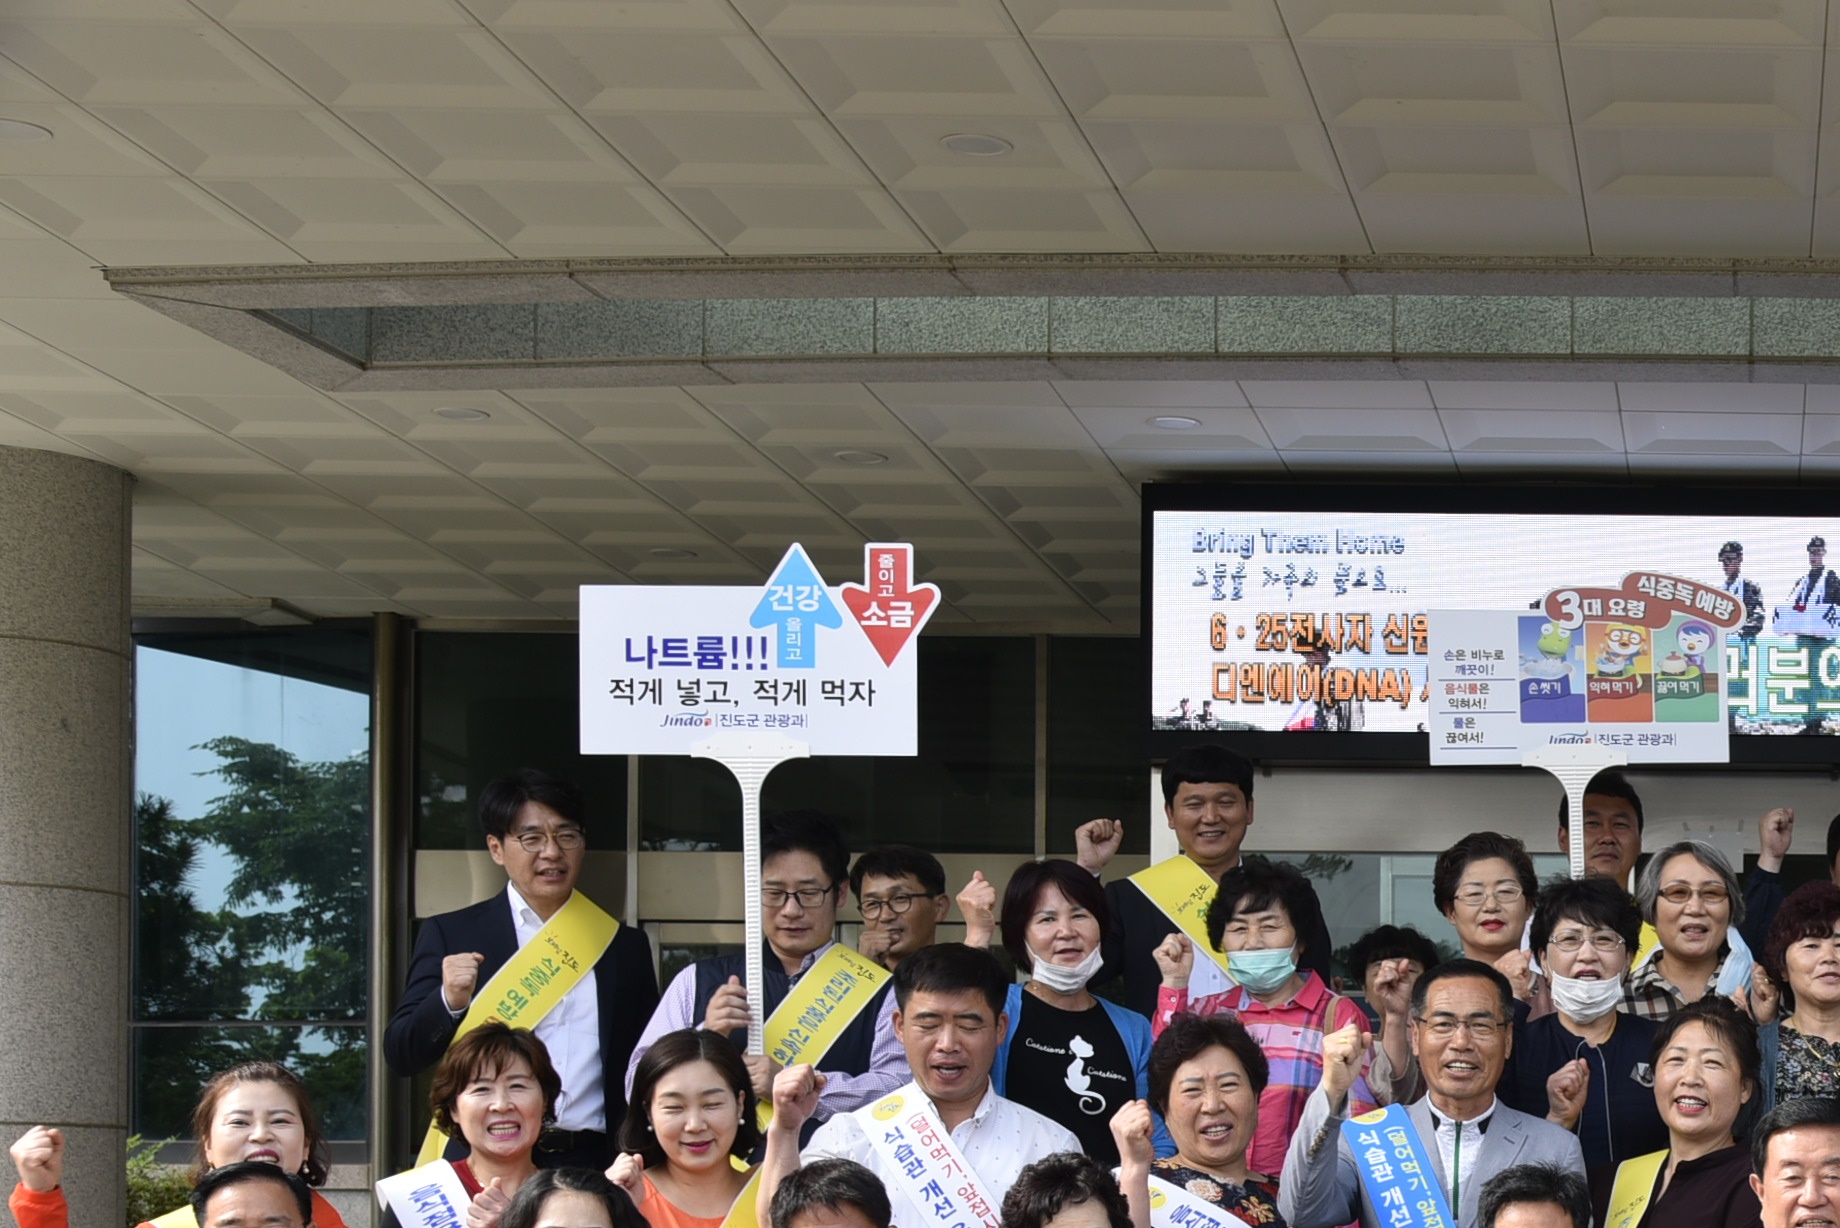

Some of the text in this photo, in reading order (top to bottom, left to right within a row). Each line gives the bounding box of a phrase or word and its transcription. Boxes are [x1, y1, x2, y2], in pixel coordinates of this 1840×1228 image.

[1192, 528, 1405, 560] Bring Them Home
[877, 554, 896, 598] 줄이고
[767, 585, 822, 612] 건강
[1555, 590, 1646, 631] 3대 요령
[1638, 575, 1736, 621] 식중독 예방
[860, 601, 915, 628] 소금
[625, 635, 768, 670] 나트륨!!!
[785, 617, 803, 661] 올리고
[1443, 649, 1505, 661] 손은 비누로
[1454, 664, 1495, 676] 깨끗이!
[609, 678, 876, 707] 적게 넣고, 적게 먹자
[1444, 682, 1490, 695] 음식물은
[1447, 697, 1487, 710] 익혀서!
[720, 714, 759, 728] 진도군
[763, 714, 804, 728] 관광과
[1453, 717, 1476, 729] 물은
[1599, 733, 1634, 746] 진도군
[1637, 734, 1674, 747] 관광과
[496, 989, 529, 1021] 예방
[883, 1126, 927, 1180] 식습관
[919, 1178, 957, 1221] 개선
[1357, 1129, 1395, 1183] 식습관
[1380, 1186, 1413, 1228] 개선
